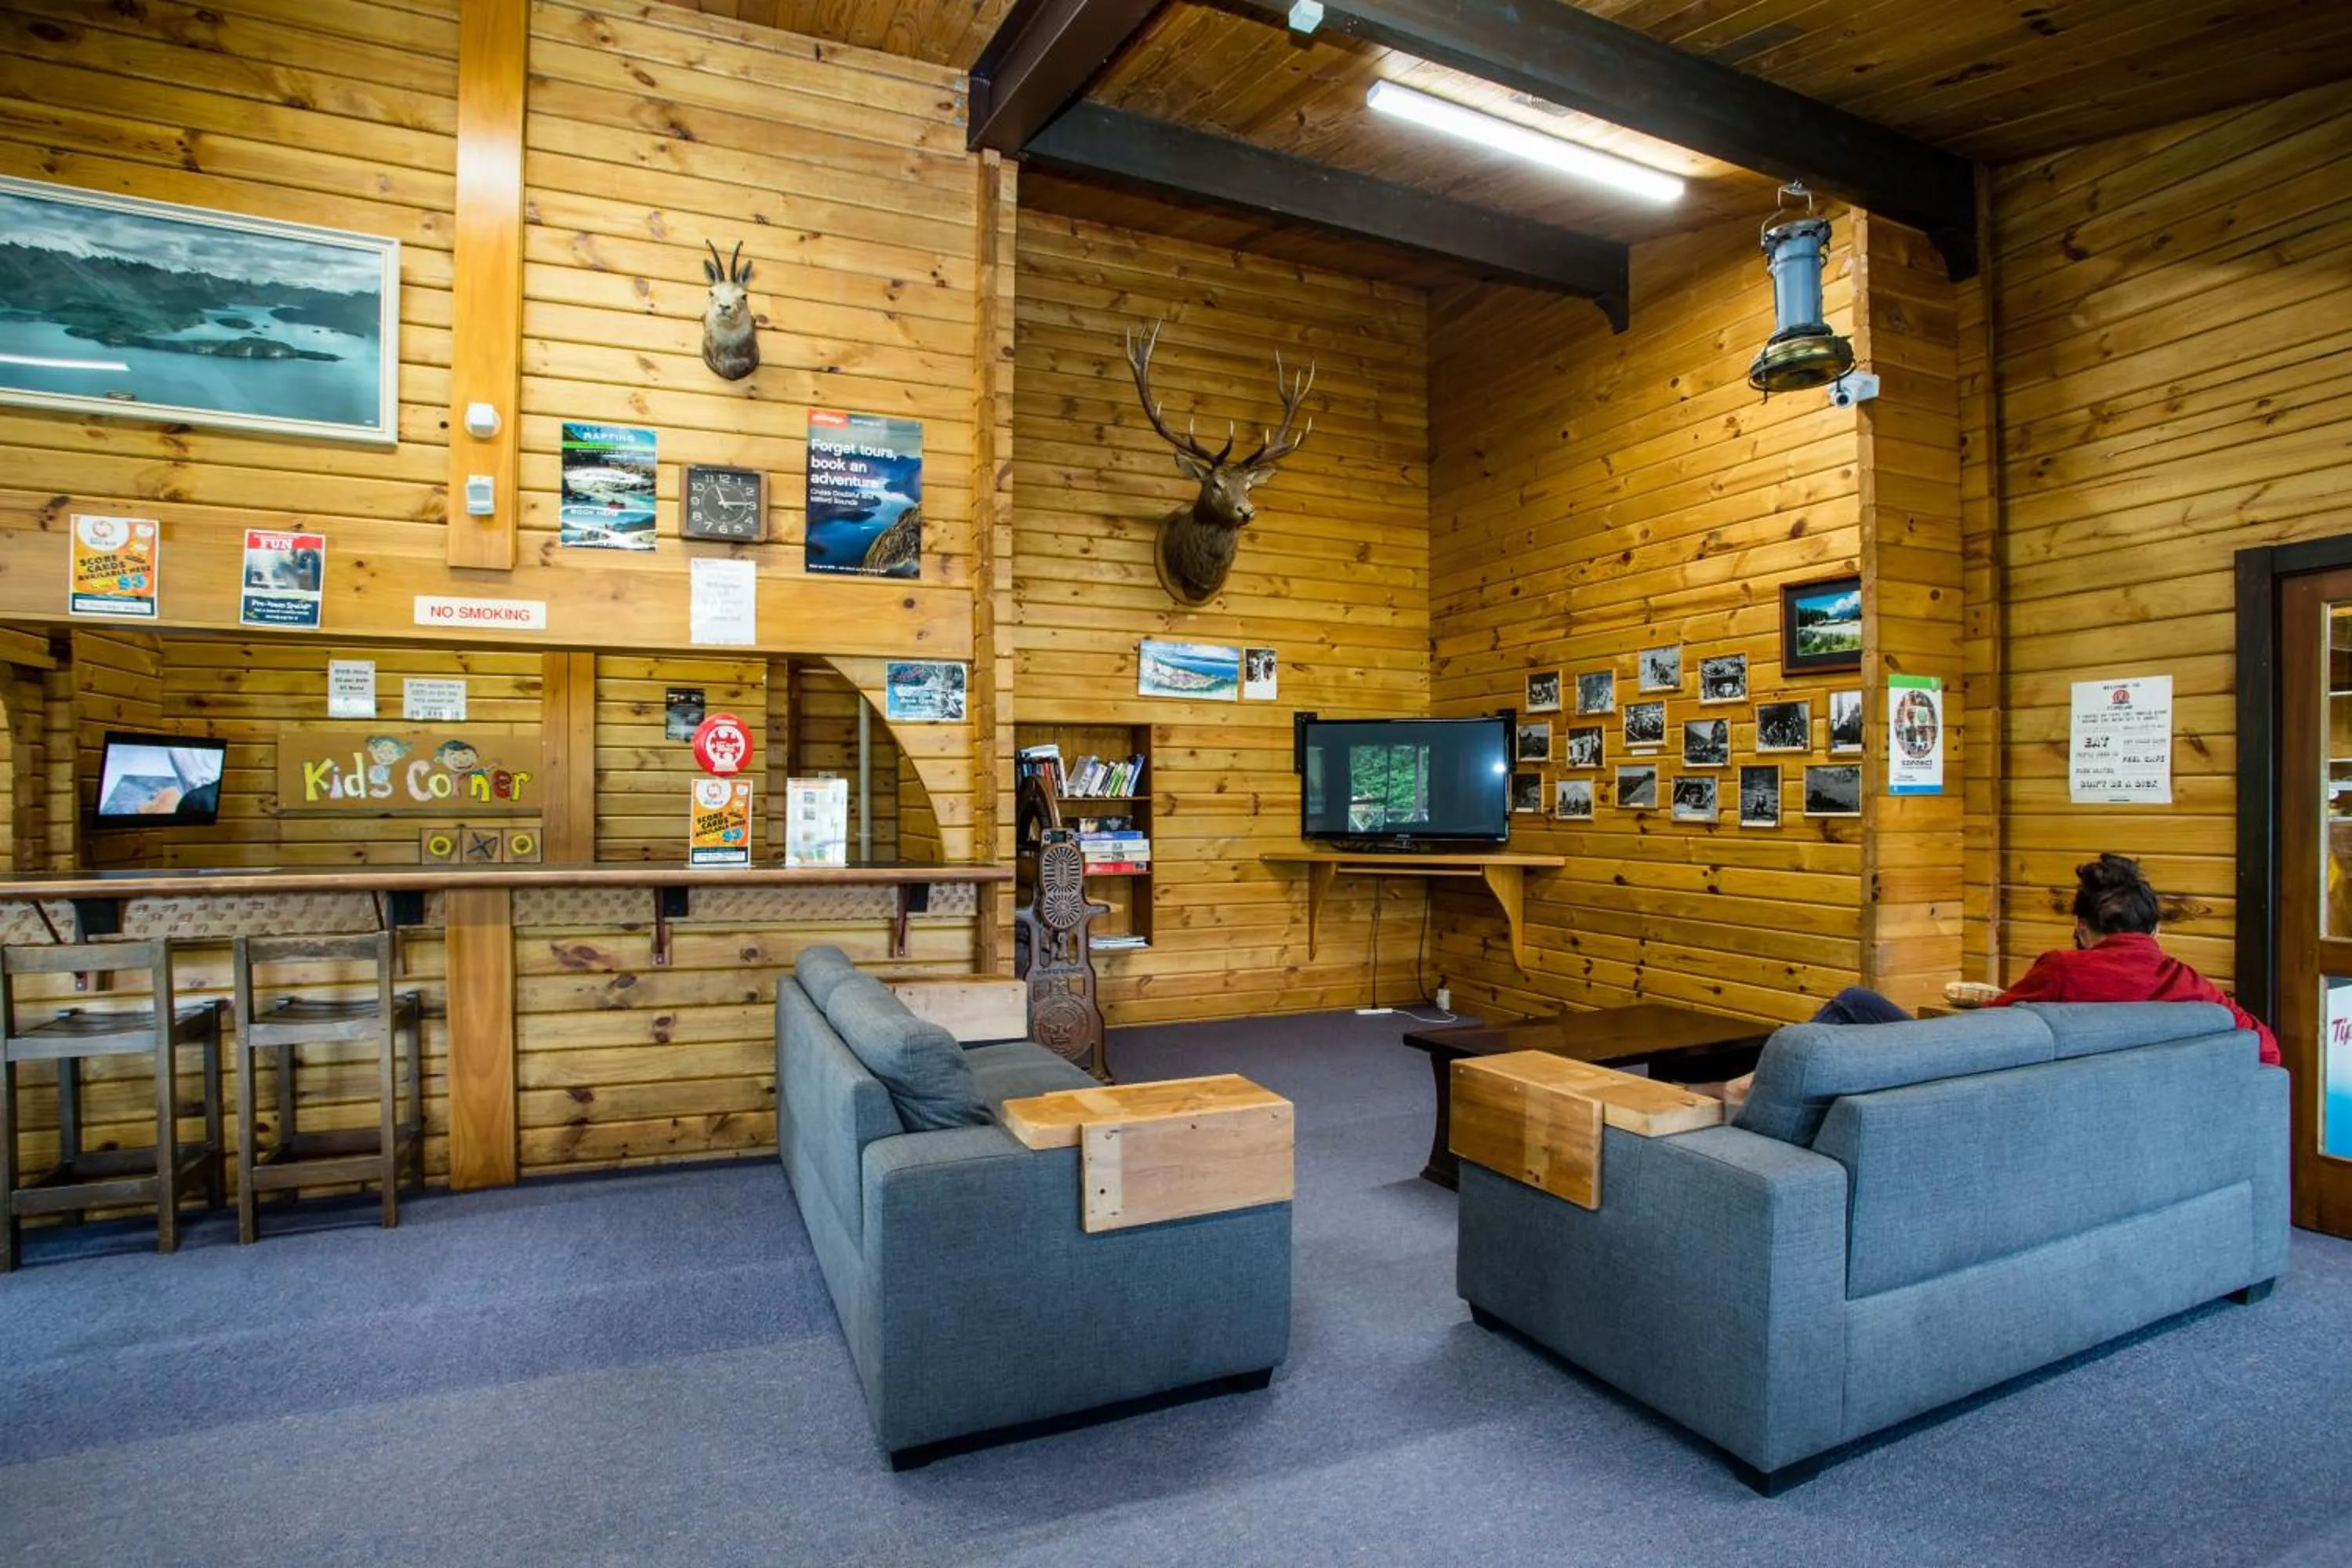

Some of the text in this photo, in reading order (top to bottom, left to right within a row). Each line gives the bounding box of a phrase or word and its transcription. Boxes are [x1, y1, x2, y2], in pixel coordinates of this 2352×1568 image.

[811, 437, 898, 461] Forget tours,
[811, 455, 868, 473] book an
[705, 474, 715, 484] 11
[718, 474, 731, 484] 12
[691, 482, 705, 492] 10
[746, 486, 754, 496] 2
[690, 496, 700, 506] 9
[748, 501, 757, 511] 3
[692, 511, 702, 521] 8
[744, 516, 753, 524] 4
[703, 521, 713, 531] 7
[718, 524, 728, 534] 6
[733, 523, 744, 533] 5
[260, 537, 295, 551] FUN
[79, 554, 118, 566] SCORE
[87, 561, 127, 573] CARDS
[430, 605, 531, 622] NO SMOKING
[303, 752, 533, 803] Kids Corner
